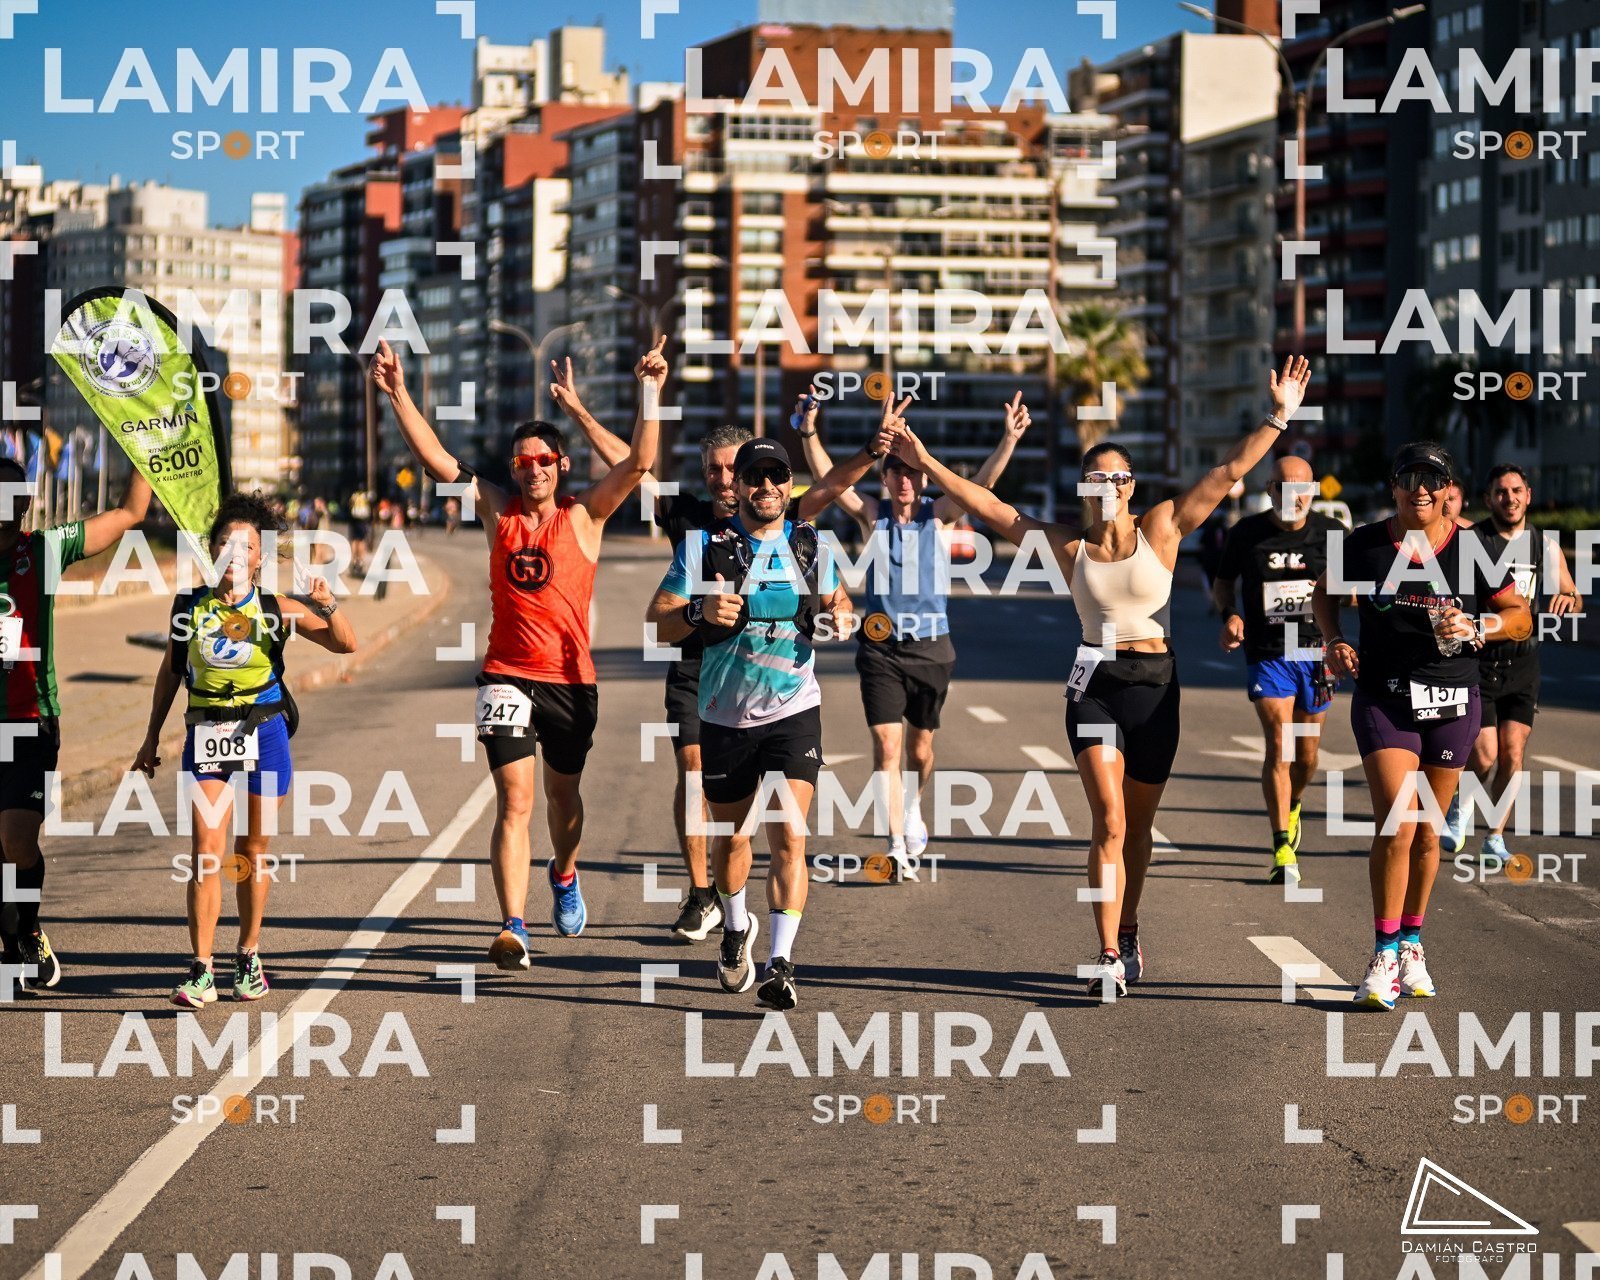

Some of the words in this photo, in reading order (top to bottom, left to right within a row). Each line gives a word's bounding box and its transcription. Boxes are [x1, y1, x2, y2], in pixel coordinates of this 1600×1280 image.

[121, 412, 198, 433] GARMIN
[162, 468, 203, 481] KILOMETRO
[1273, 597, 1306, 613] 287
[1423, 685, 1457, 703] 157
[482, 703, 520, 722] 247
[205, 736, 246, 758] 908
